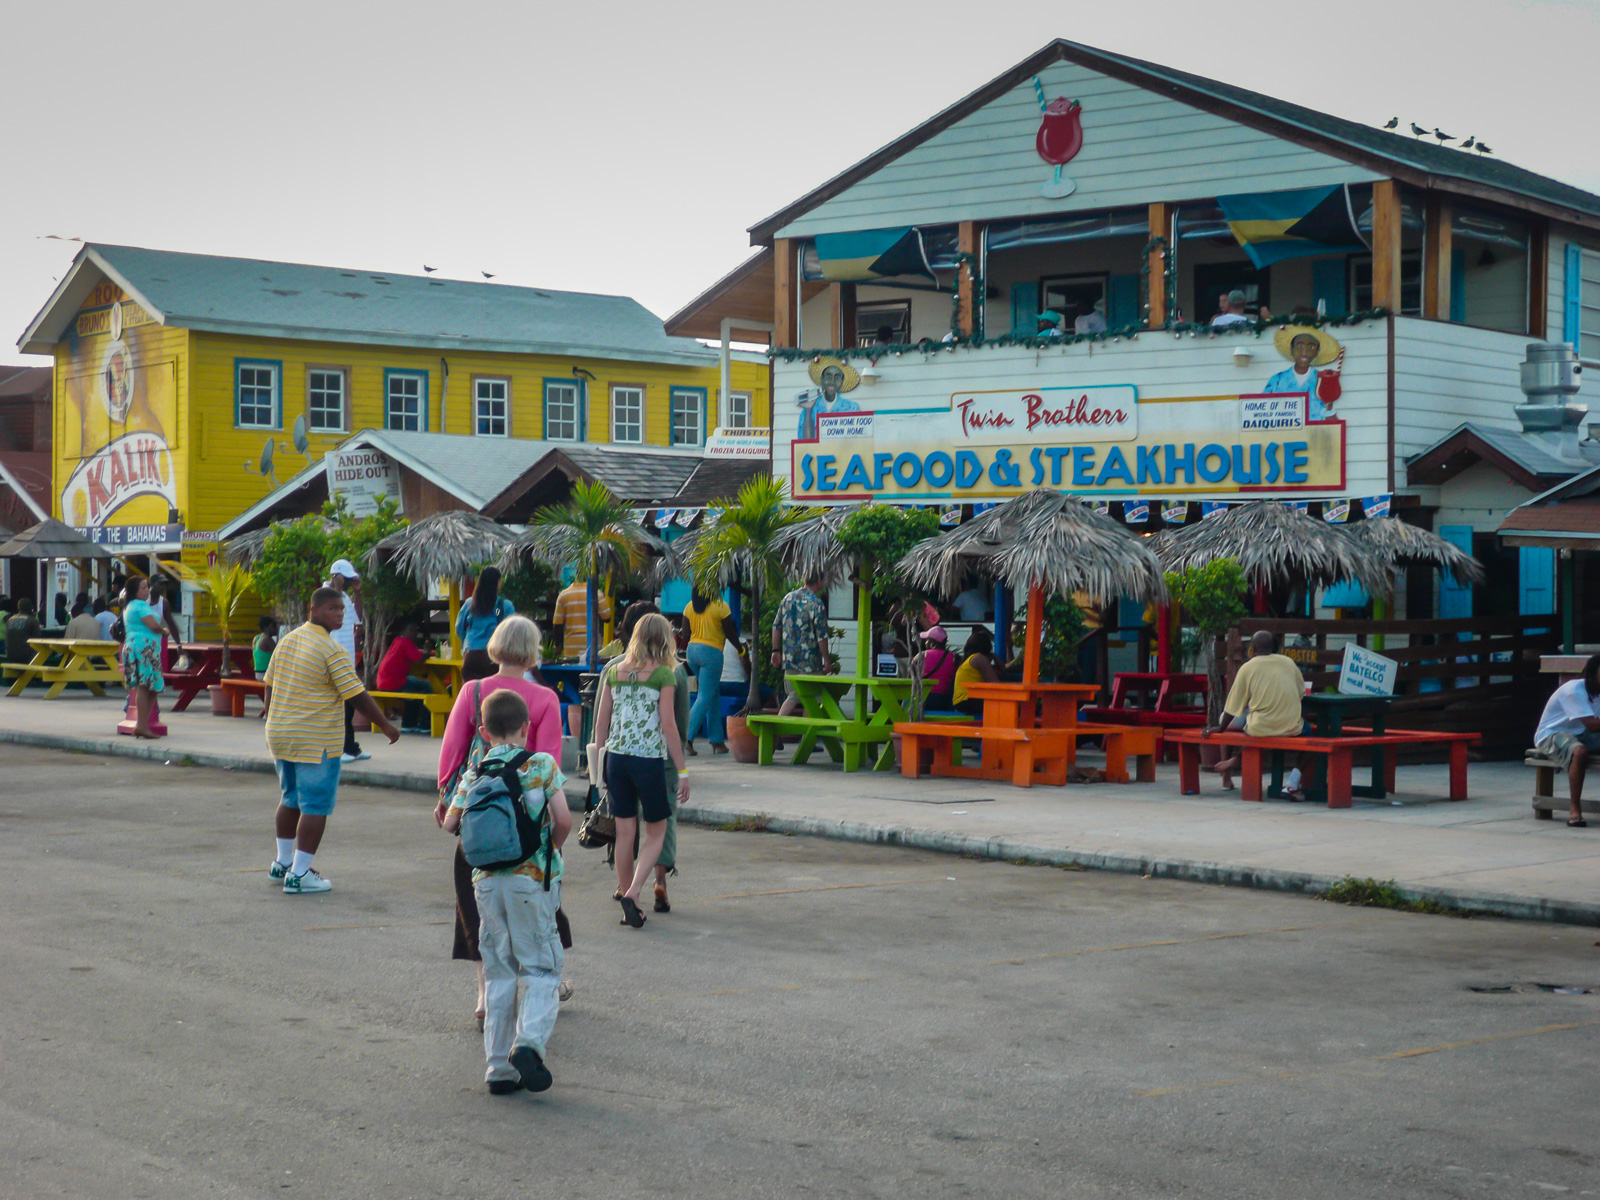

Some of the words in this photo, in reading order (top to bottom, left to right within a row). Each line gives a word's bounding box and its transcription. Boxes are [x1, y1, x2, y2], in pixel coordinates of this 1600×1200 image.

[1245, 402, 1266, 411] HOME
[1270, 402, 1279, 410] OF
[1284, 401, 1298, 409] THE
[821, 419, 839, 427] DOWN
[840, 418, 855, 426] HOME
[856, 417, 873, 426] FOOD
[957, 398, 1015, 437] Twin
[1021, 394, 1128, 432] Brothers
[1243, 418, 1301, 429] DAIQUIRIS
[827, 428, 844, 436] DOWN
[847, 427, 864, 435] HOME
[338, 453, 387, 467] ANDROS
[801, 451, 984, 491] SEAFOOD
[988, 449, 1022, 487] &
[1030, 441, 1308, 486] STEAKHOUSE
[86, 438, 161, 521] KALIK
[335, 468, 365, 482] HIDE
[365, 466, 391, 479] OUT
[92, 527, 102, 543] OF
[106, 527, 120, 542] THE
[127, 525, 166, 542] BAHAMAS
[1352, 650, 1362, 663] We
[1349, 663, 1384, 683] BATELCO
[1346, 677, 1363, 688] meal
